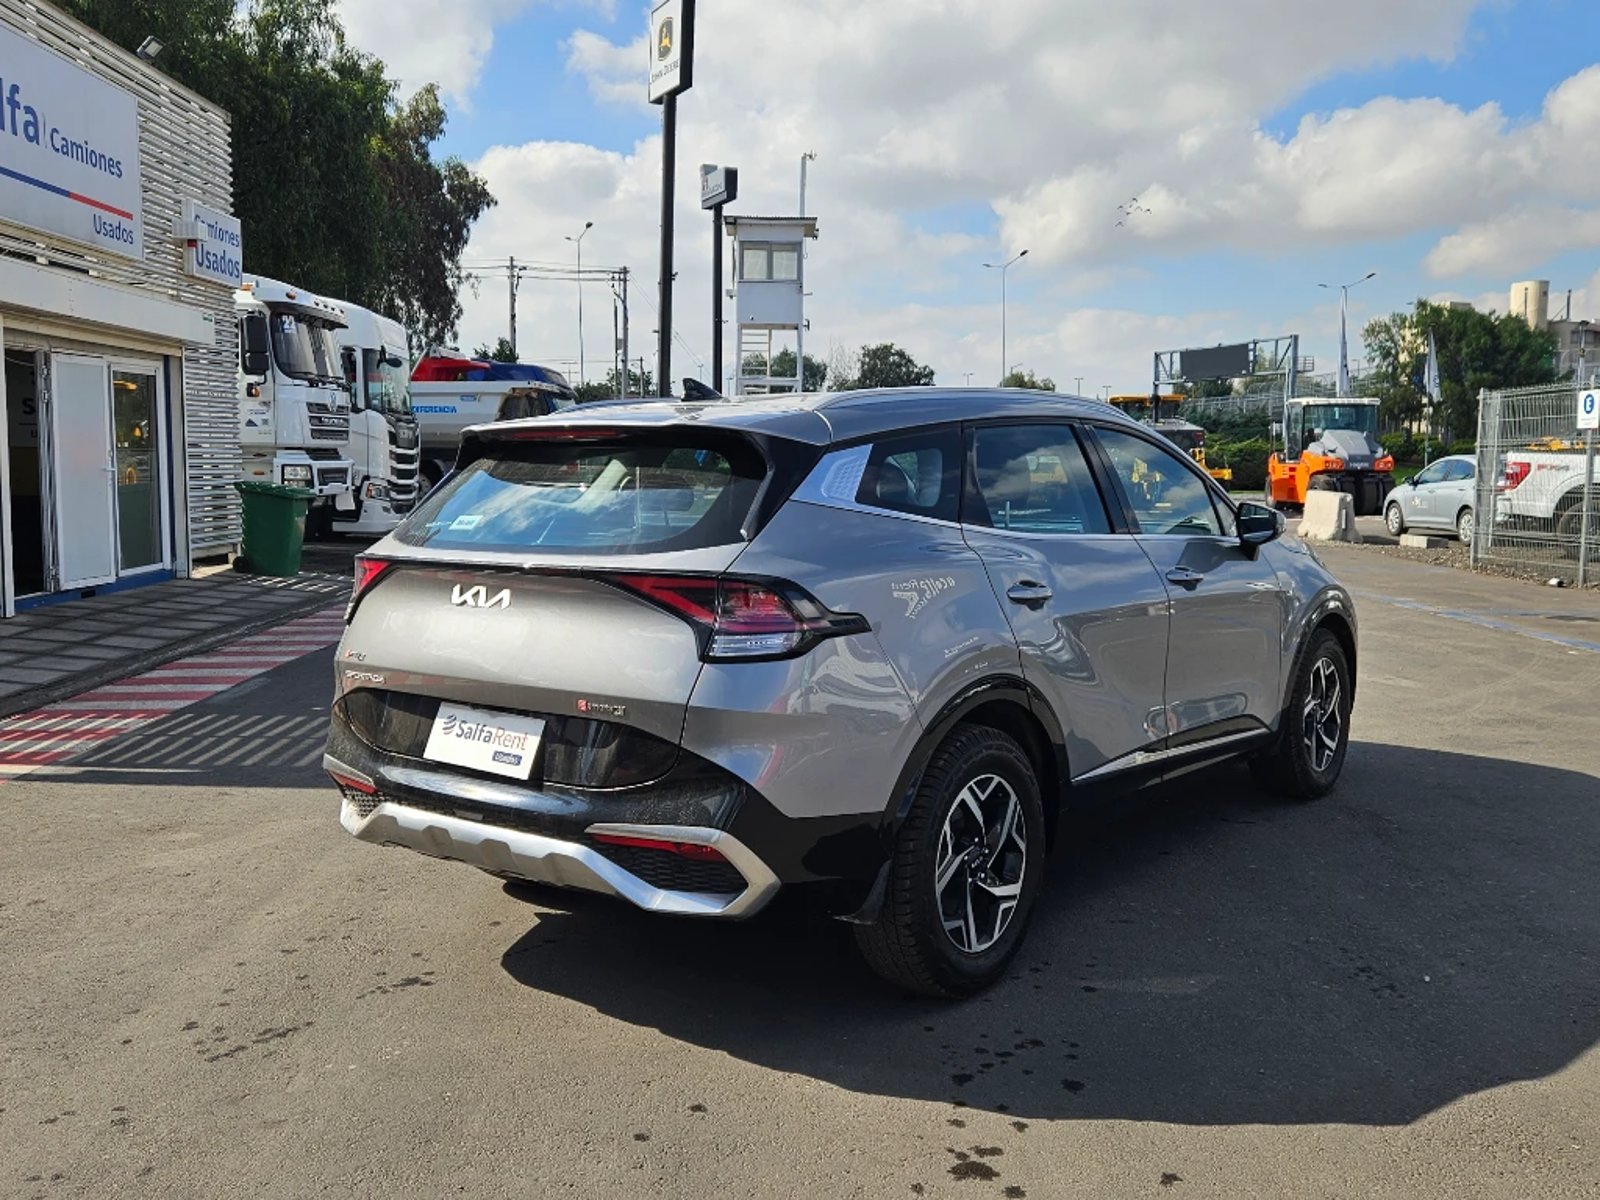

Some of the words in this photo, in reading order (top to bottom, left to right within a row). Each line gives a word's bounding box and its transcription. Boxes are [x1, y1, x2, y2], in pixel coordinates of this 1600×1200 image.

[50, 127, 123, 179] Camiones
[93, 213, 134, 245] Usados
[194, 214, 240, 248] miones
[195, 243, 240, 278] Usados
[451, 583, 511, 610] KIA
[455, 719, 529, 751] SalfaRent
